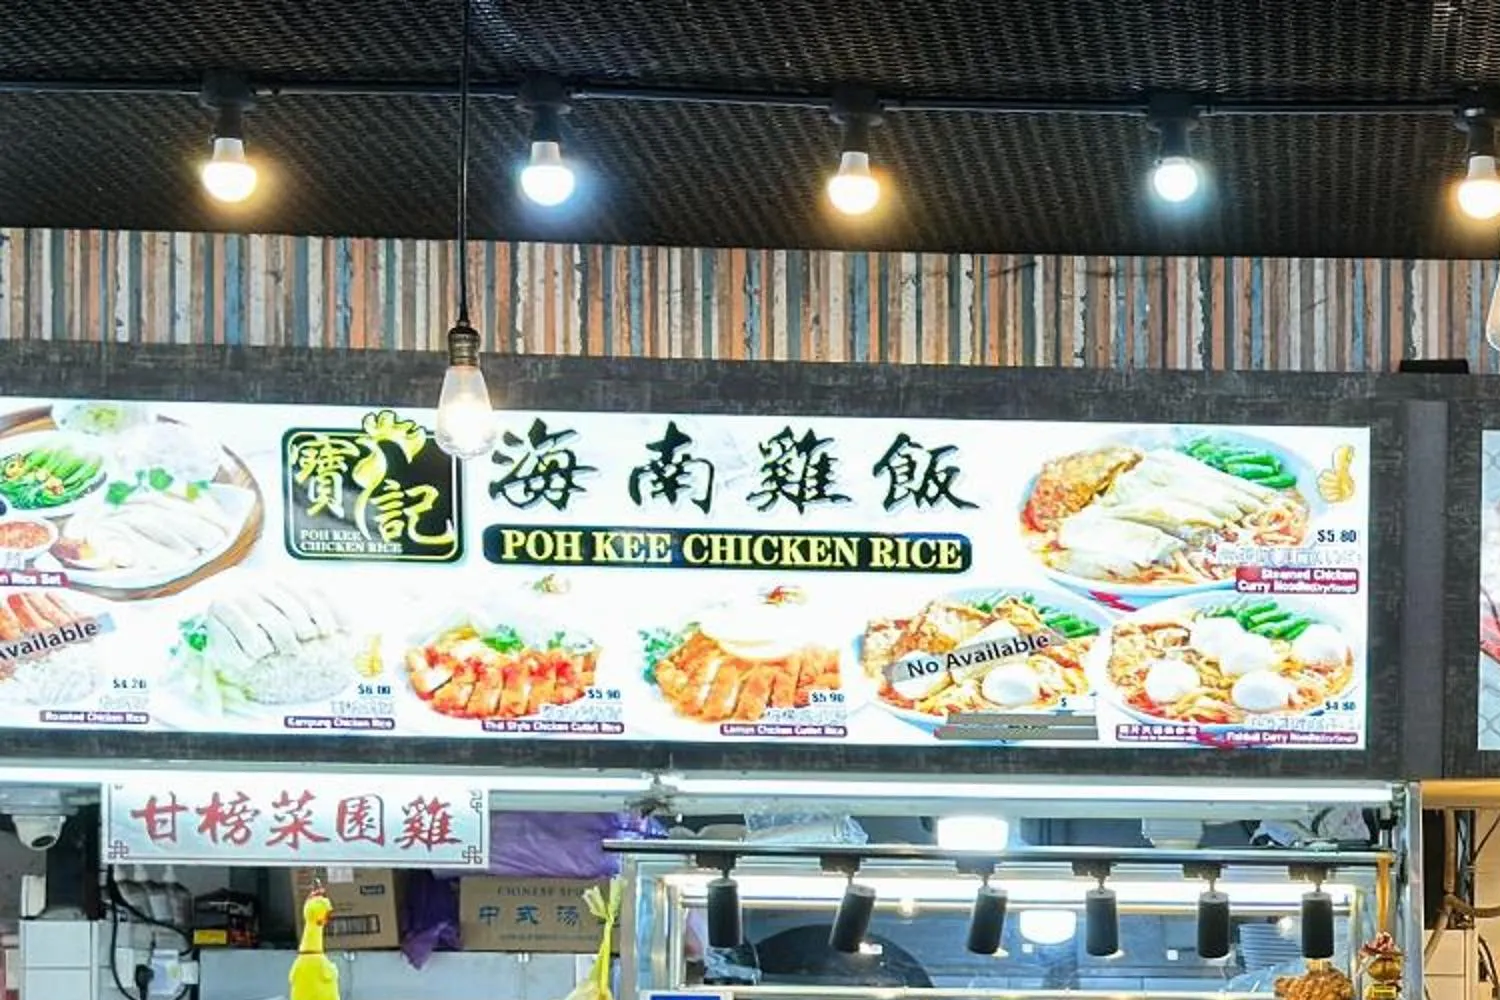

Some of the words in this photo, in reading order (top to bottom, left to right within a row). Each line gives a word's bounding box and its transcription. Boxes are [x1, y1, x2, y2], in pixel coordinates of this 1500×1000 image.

[488, 418, 979, 515] 海南雞飯
[501, 530, 584, 561] POH
[593, 531, 672, 563] KEE
[682, 533, 858, 567] CHICKEN
[869, 537, 963, 569] RICE
[907, 658, 940, 679] No
[945, 632, 1050, 672] Available
